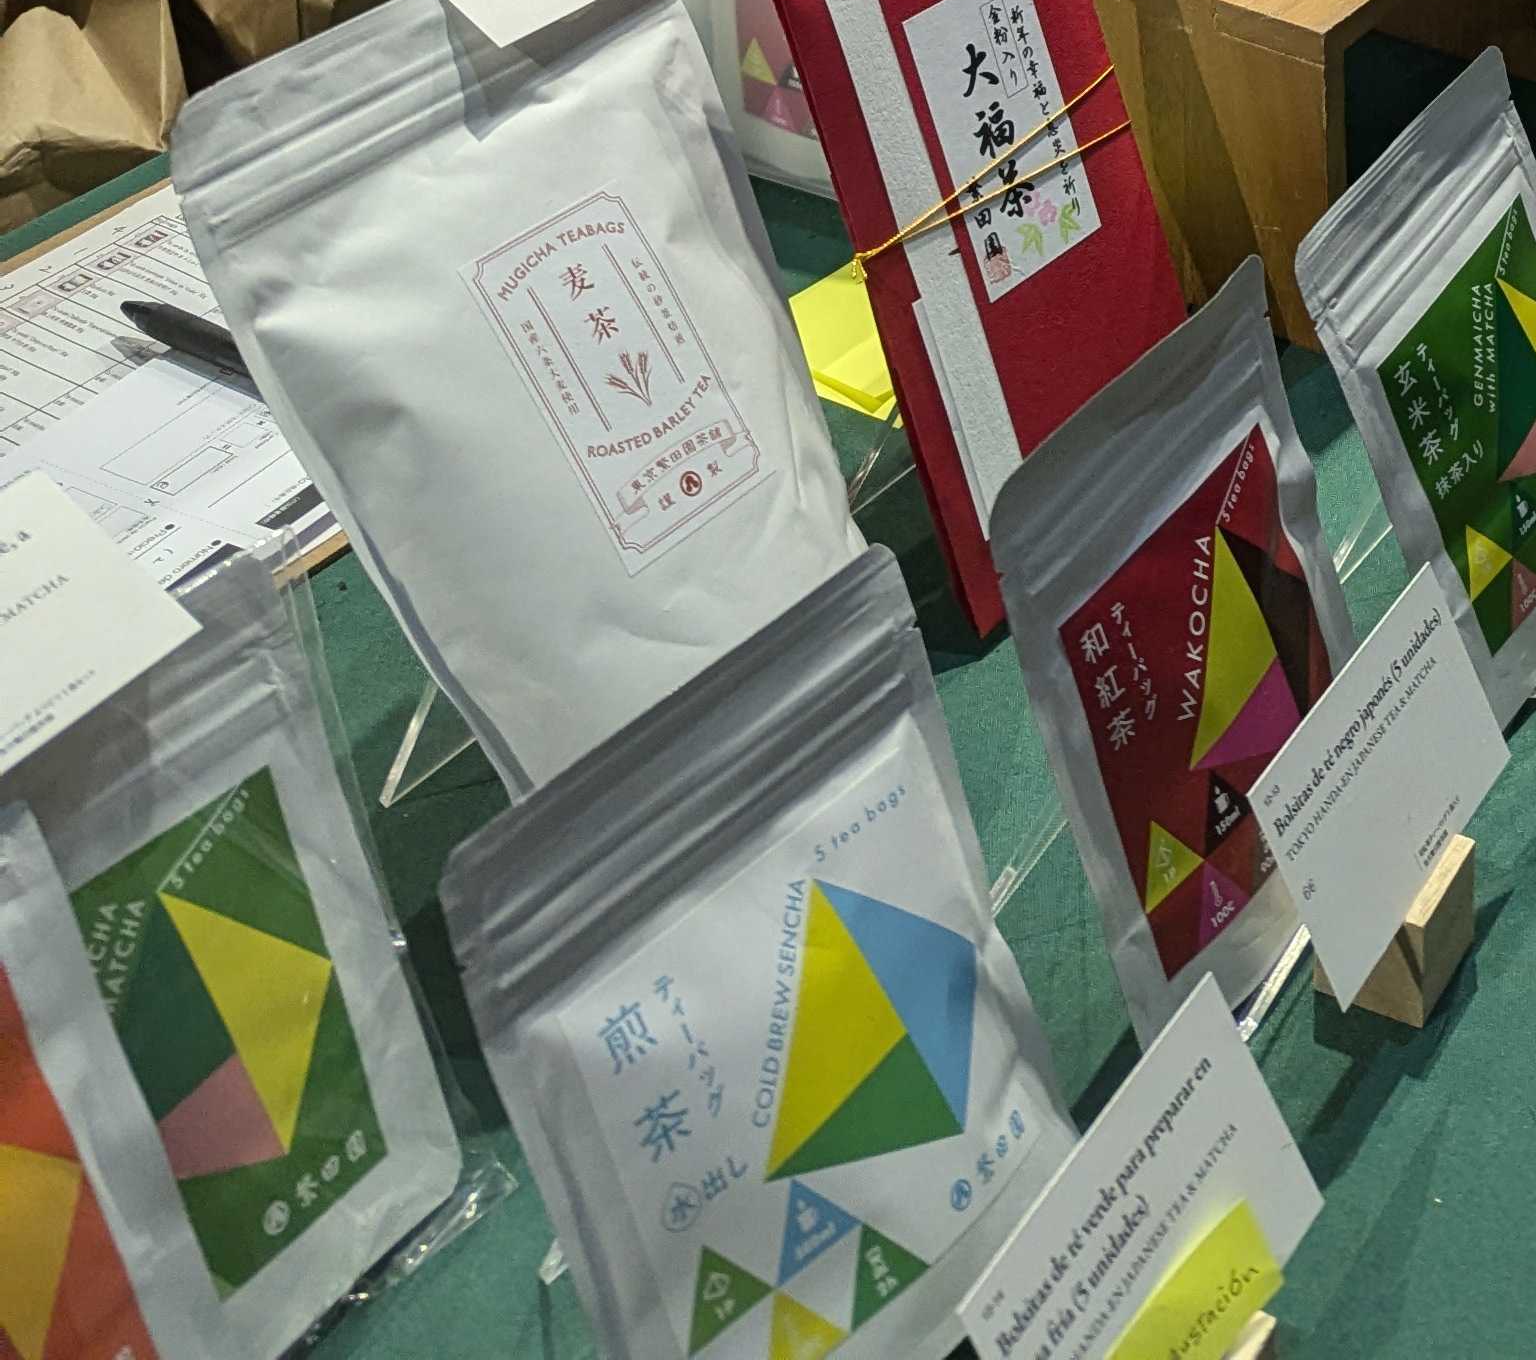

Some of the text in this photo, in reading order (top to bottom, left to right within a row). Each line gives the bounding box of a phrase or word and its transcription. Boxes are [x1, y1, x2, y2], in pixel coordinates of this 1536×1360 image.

[988, 4, 1018, 87] 金粉入り
[962, 43, 1035, 218] 大福茶
[498, 221, 625, 301] MUGICHA TEABAGS
[559, 263, 619, 344] 麦茶
[1416, 342, 1461, 441] ティーバッグ
[1472, 283, 1484, 408] GENMAICHA
[1485, 281, 1496, 414] with MATCHA
[587, 375, 711, 458] ROASTED BARLEY TEA
[1394, 361, 1445, 466] 玄米茶
[1435, 439, 1485, 500] 抹茶入り
[1226, 481, 1241, 511] tea
[1235, 443, 1257, 483] bags
[1110, 602, 1158, 721] ティーバッグ
[1177, 535, 1212, 721] WAKOCHA
[1079, 622, 1136, 752] 和紅茶
[1273, 608, 1441, 836] Bolsitas de té negro japonés (5 unidades)
[814, 783, 908, 864] 5 tea bags
[653, 975, 723, 1119] ティーバッグ
[752, 879, 806, 1128] COLD BREW SENCHA
[597, 1000, 692, 1164] 煎茶
[664, 1157, 748, 1230] 水出し
[996, 1057, 1211, 1356] Bolsitas de té verde para preparar en
[1088, 1195, 1147, 1287] unidades)
